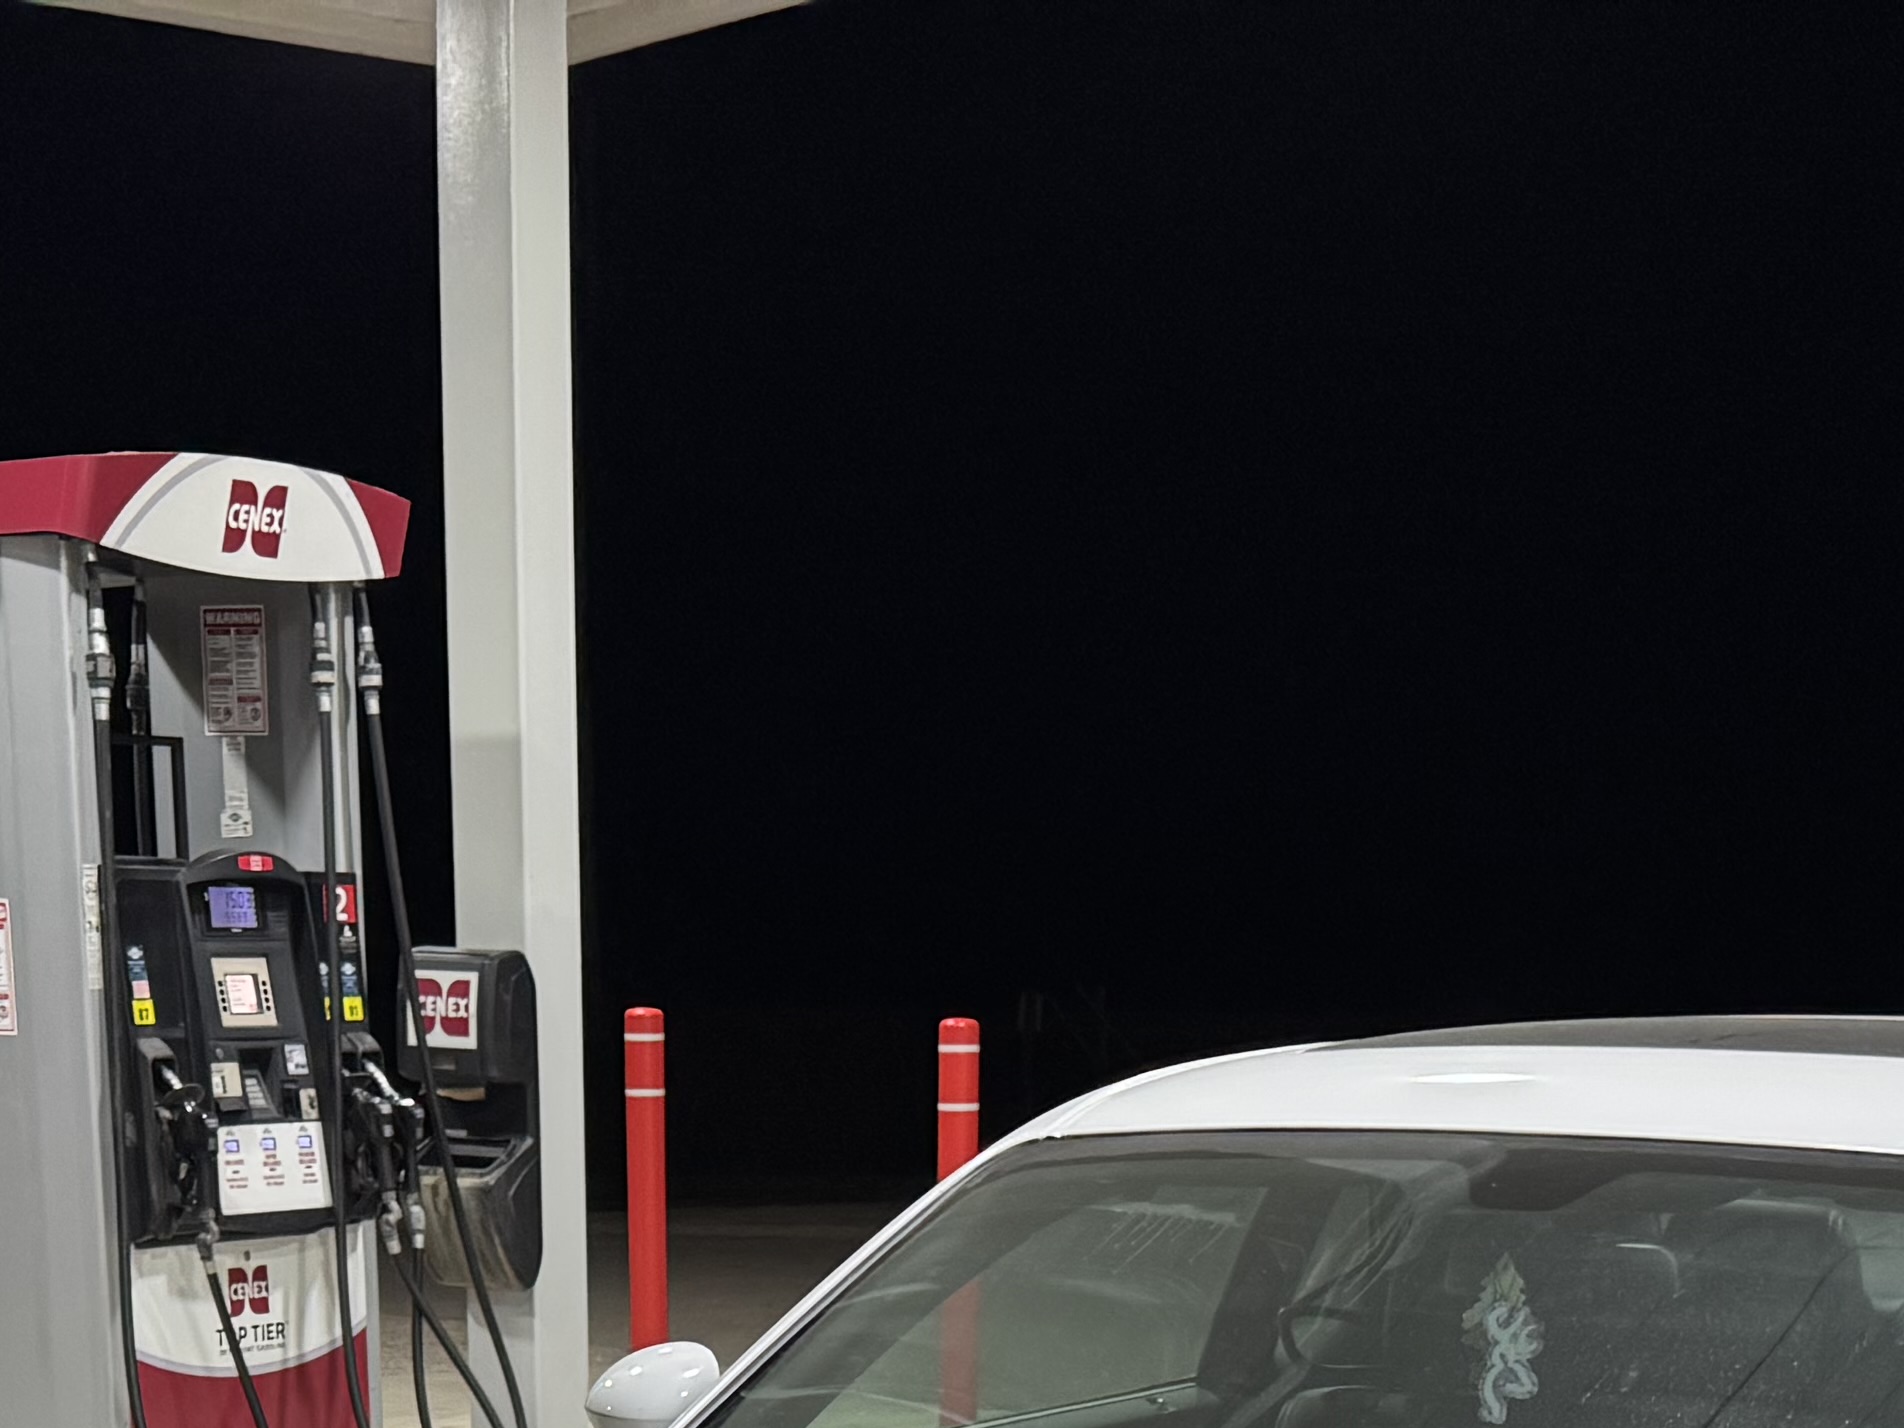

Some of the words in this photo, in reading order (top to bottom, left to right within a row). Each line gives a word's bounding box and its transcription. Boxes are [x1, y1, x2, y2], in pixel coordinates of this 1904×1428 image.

[228, 502, 284, 535] CENEX
[335, 887, 349, 921] 2
[230, 1281, 269, 1301] CENEX
[216, 1325, 248, 1347] TP
[251, 1321, 286, 1343] TIER
